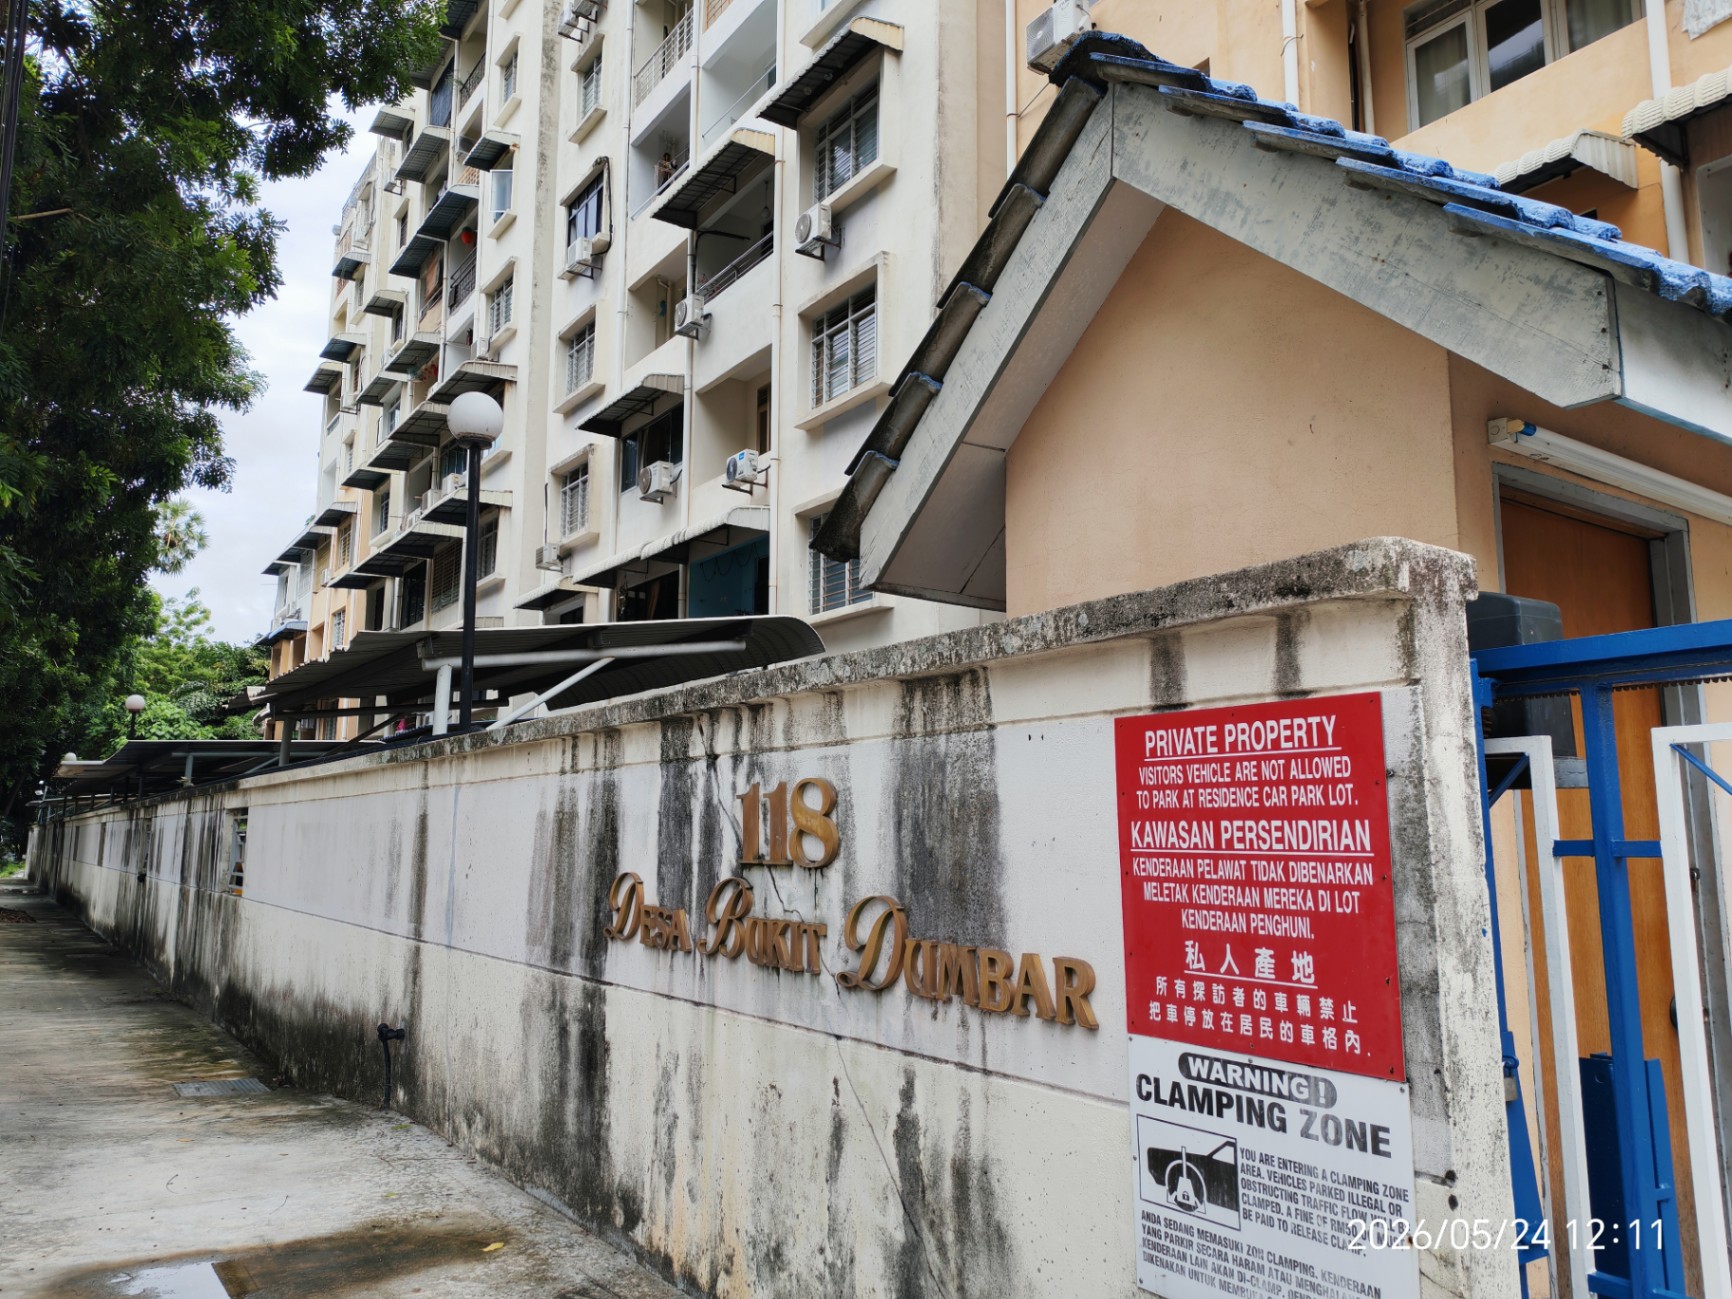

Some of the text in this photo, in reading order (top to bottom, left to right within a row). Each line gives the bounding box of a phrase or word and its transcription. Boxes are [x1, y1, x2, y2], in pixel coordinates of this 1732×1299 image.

[1145, 715, 1336, 757] PRIVATE PROPERTY
[1139, 756, 1351, 785] VISITORS VEHICLE ARE NOT ALLOWED
[1136, 783, 1358, 809] TO PARK AT RESIDENCE CAR PARK LOT.
[736, 777, 839, 868] 118
[1131, 819, 1371, 851] KAWASAN PERSENDIRIAN
[1133, 857, 1373, 886] KENDERAAN PELAWAT TIDAK DIBENARKAN
[1143, 881, 1360, 914] MELETAK KENDERAAN MEREKA DI LOT
[1181, 908, 1314, 939] KENDERAAN PENGHUNI.
[1185, 940, 1315, 984] 私人產地
[1136, 1073, 1392, 1158] CLAMPING ZONE
[1240, 1147, 1409, 1203] YOU ARE ENTERING A CLAMPING ZONE
[1240, 1162, 1403, 1218] AREA. VEHICLES PARKED ILLEGAL OR
[1240, 1177, 1299, 1205] OBSTRUCTING
[1301, 1194, 1338, 1216] TRAFFIC
[1341, 1206, 1367, 1224] FLOW
[1241, 1192, 1284, 1216] CLAMPED.
[1286, 1205, 1292, 1218] A
[1294, 1208, 1314, 1225] FINE
[1316, 1214, 1328, 1228] OF
[1242, 1207, 1253, 1222] BE
[1255, 1211, 1275, 1228] PAID
[1277, 1218, 1288, 1233] TO
[1291, 1222, 1329, 1245] RELEASE
[1141, 1209, 1162, 1226] ANDA
[1163, 1217, 1194, 1237] SEDANG
[1197, 1227, 1243, 1254] MEMASUKI
[1266, 1251, 1318, 1279] CLAMPING.
[1320, 1269, 1382, 1299] KENDERAAN
[1142, 1223, 1162, 1241] YANG
[1164, 1231, 1194, 1251] PARKIR
[1196, 1242, 1230, 1264] SECARA
[1231, 1254, 1265, 1276] HARAM
[1268, 1266, 1292, 1286] ATAU
[1142, 1237, 1188, 1263] KENDERAAN
[1189, 1254, 1208, 1270] LAIN
[1211, 1261, 1235, 1280] AKAN
[1188, 1268, 1216, 1288] UNTUK
